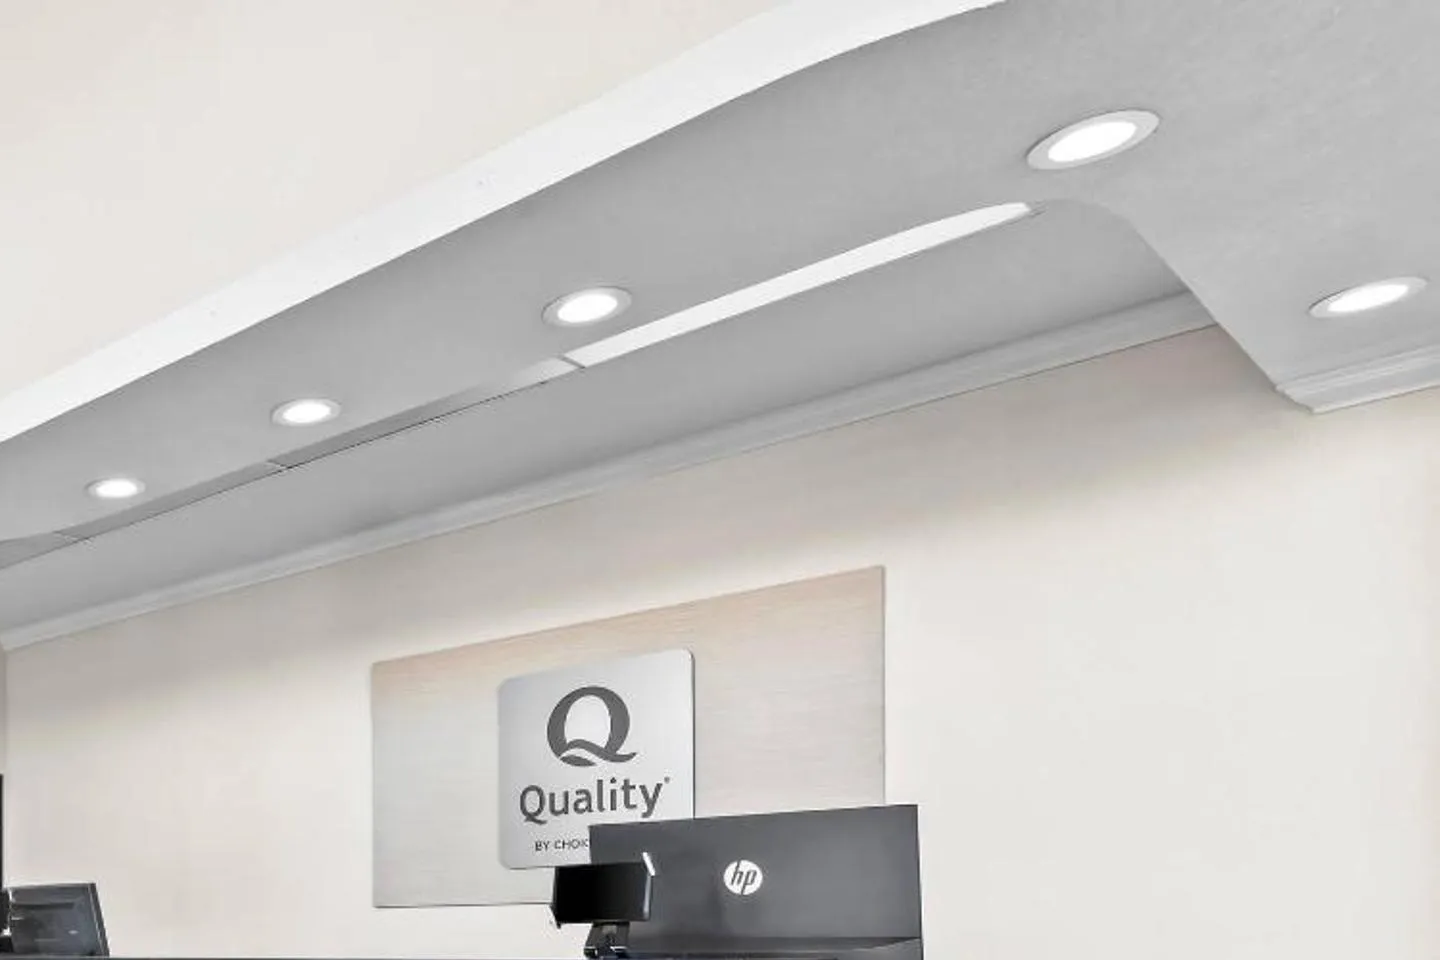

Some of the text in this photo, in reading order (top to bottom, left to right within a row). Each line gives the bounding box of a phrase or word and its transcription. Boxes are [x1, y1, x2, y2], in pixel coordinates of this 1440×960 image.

[547, 686, 637, 767] Q
[520, 777, 663, 825] Quality
[535, 840, 550, 851] BY
[730, 860, 758, 895] hp
